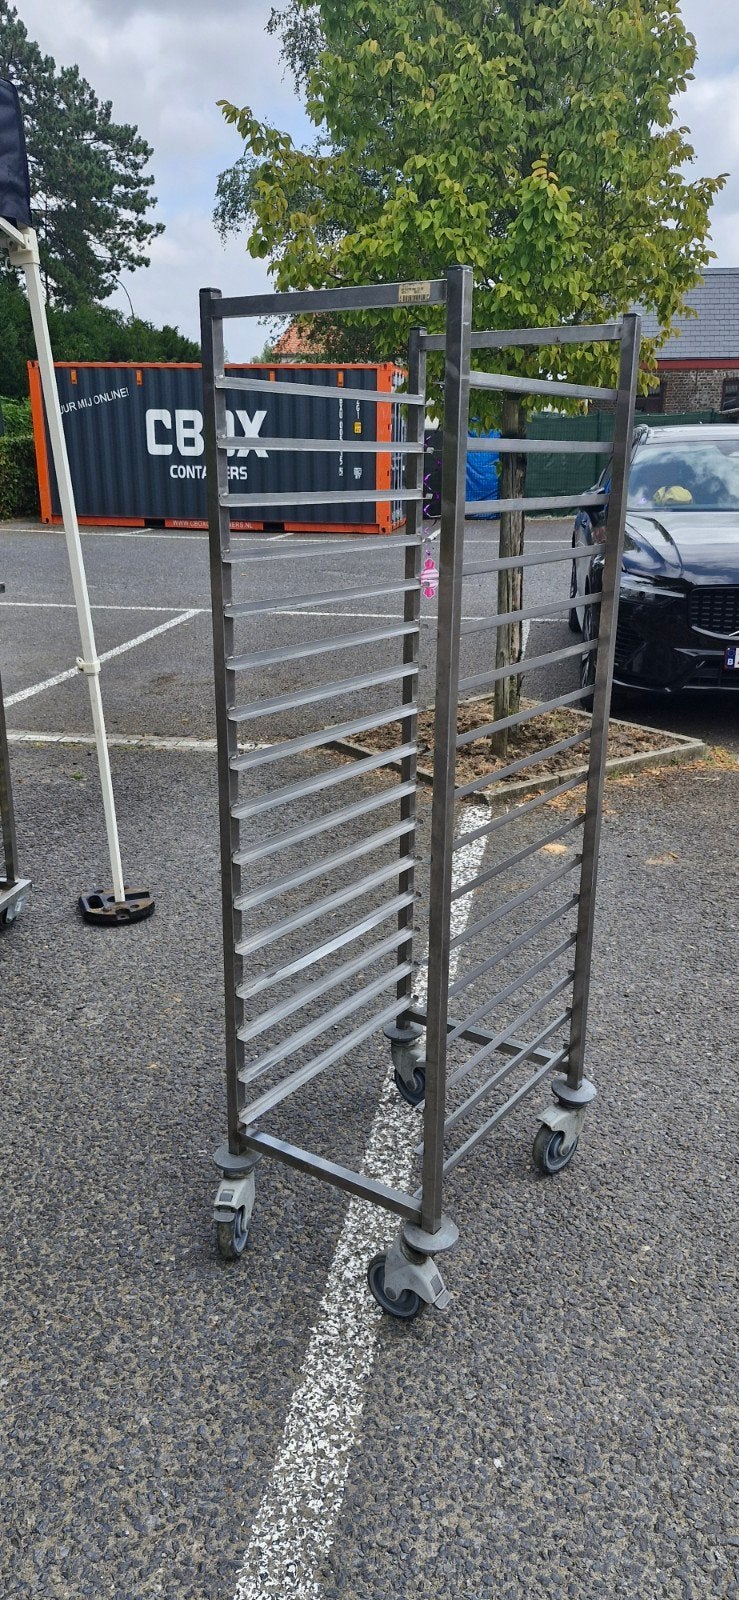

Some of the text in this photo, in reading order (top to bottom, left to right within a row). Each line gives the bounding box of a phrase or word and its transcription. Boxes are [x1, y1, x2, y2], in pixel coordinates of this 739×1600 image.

[77, 398, 92, 410] MIJ
[93, 387, 129, 405] ONLINE!
[145, 409, 269, 458] CBX
